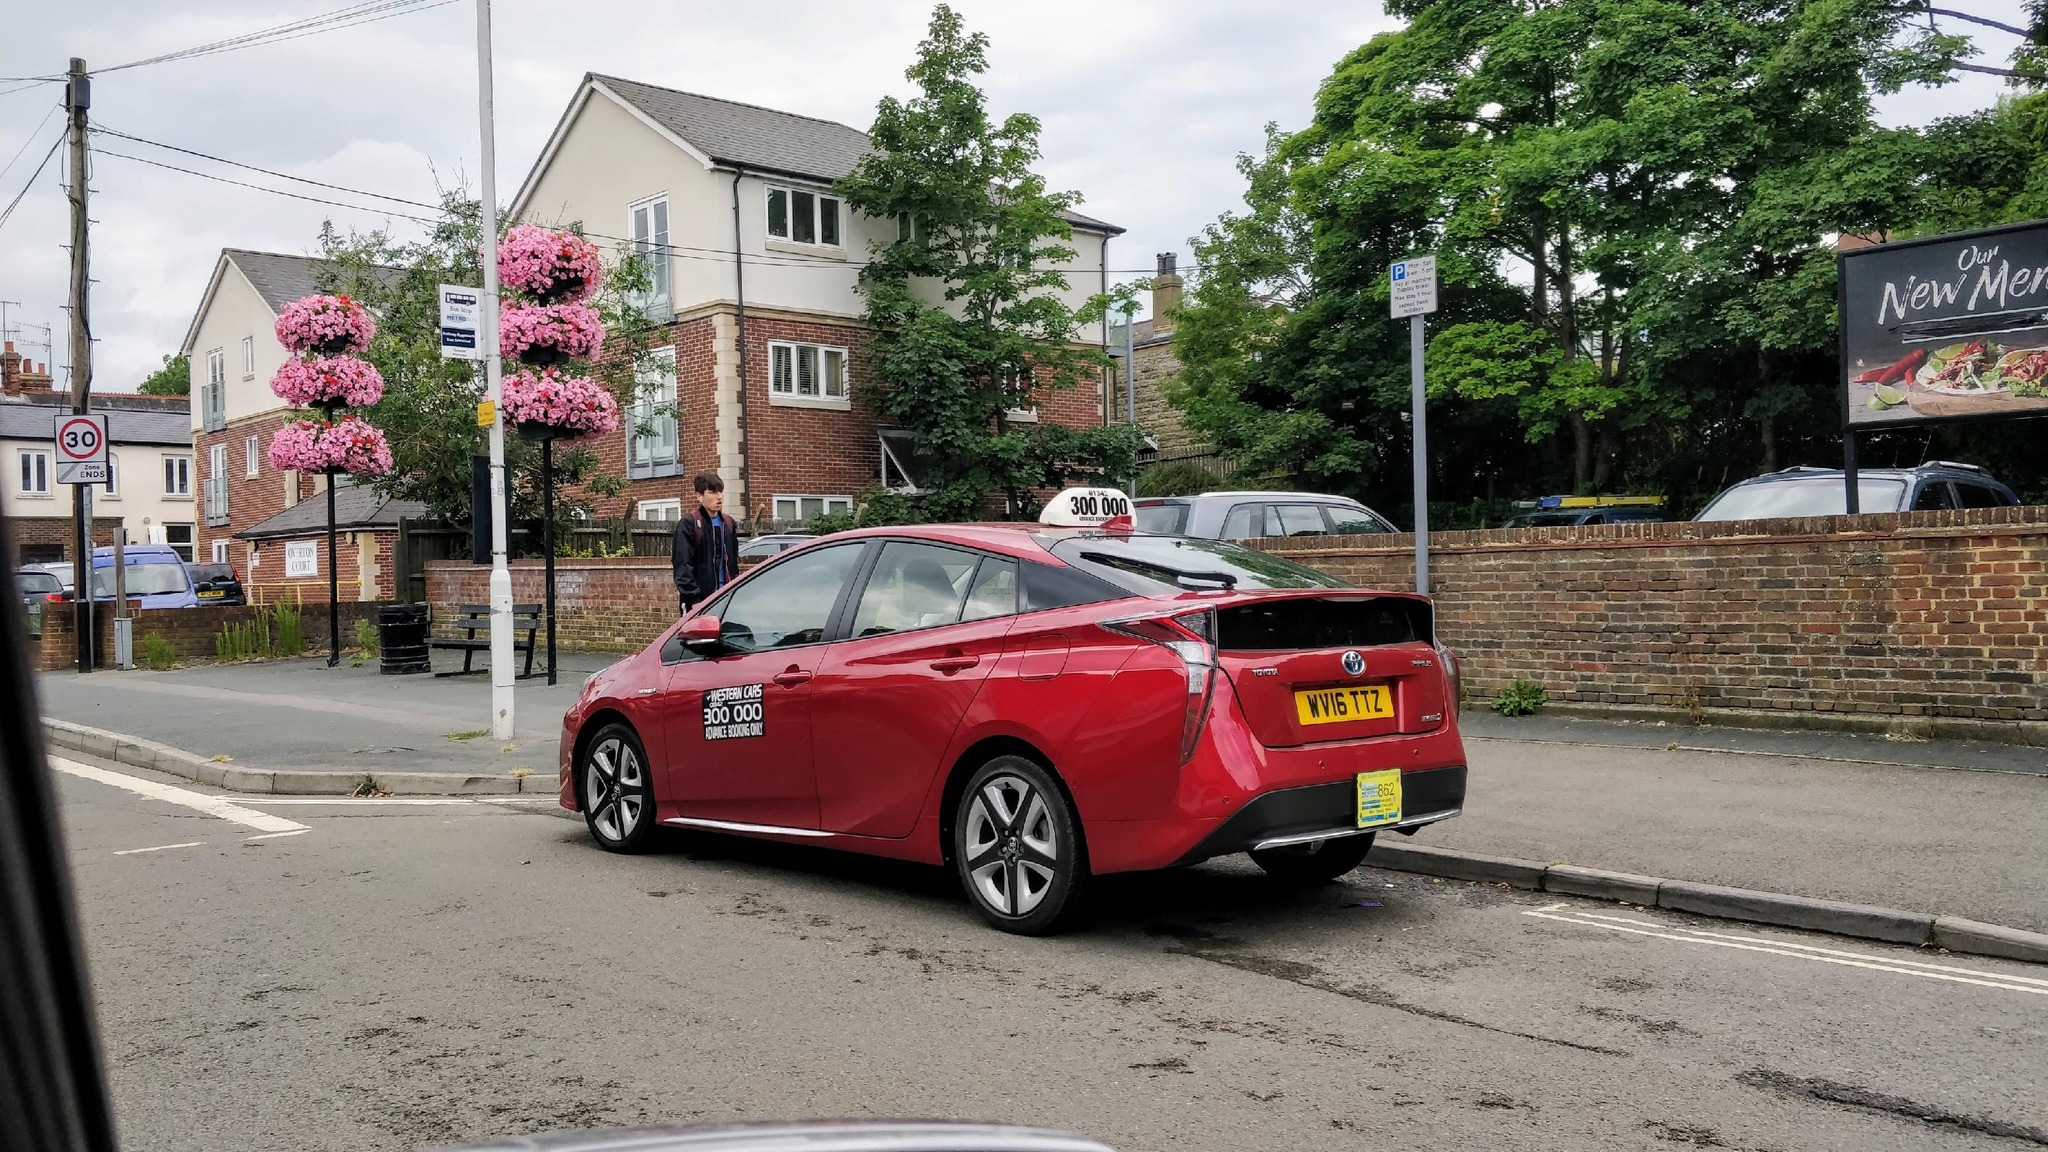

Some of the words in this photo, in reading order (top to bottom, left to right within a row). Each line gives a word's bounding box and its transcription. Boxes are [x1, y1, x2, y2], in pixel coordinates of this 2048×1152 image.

[1957, 245, 2000, 271] Our
[1395, 265, 1404, 280] P
[1877, 273, 1968, 325] New
[1967, 259, 2048, 311] Men
[460, 306, 473, 315] Stop
[65, 430, 96, 448] 30
[80, 470, 106, 478] ENDS
[1070, 496, 1098, 516] 300
[1101, 497, 1128, 516] 000
[287, 546, 315, 558] OVERTON
[291, 560, 311, 572] COURT
[1251, 667, 1279, 677] TOYOTA
[711, 686, 743, 702] WESTERN
[743, 684, 763, 699] CARS
[1306, 692, 1348, 719] WV16
[1349, 689, 1384, 714] TTZ
[703, 706, 730, 726] 300
[733, 702, 763, 722] 000
[705, 725, 728, 740] ADVANCE
[727, 723, 750, 738] BOOKING
[750, 721, 764, 736] ONLY
[1377, 782, 1395, 798] 862
